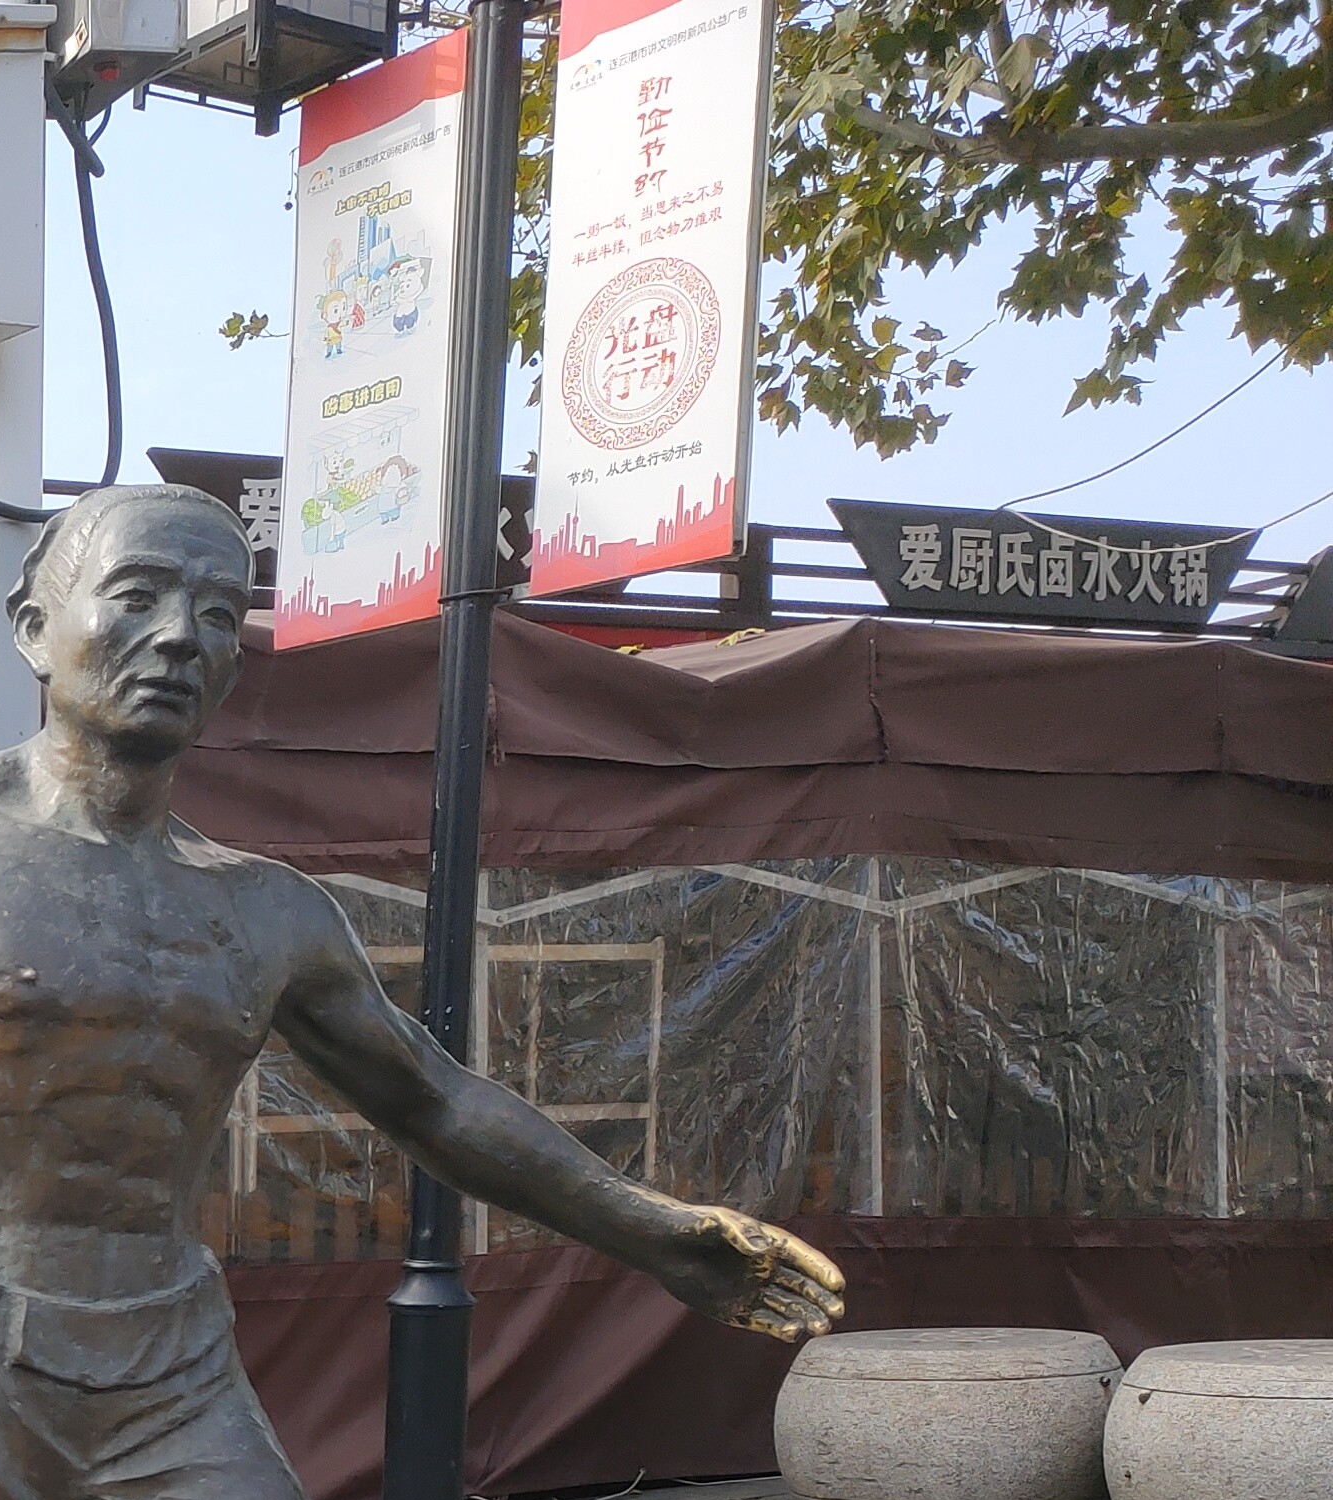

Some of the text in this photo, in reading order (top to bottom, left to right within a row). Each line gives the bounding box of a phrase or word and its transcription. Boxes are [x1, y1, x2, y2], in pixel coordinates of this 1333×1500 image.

[604, 303, 678, 360] 光盘
[602, 348, 677, 405] 行动
[899, 523, 1209, 607] 爱厨氏卤水火锅
